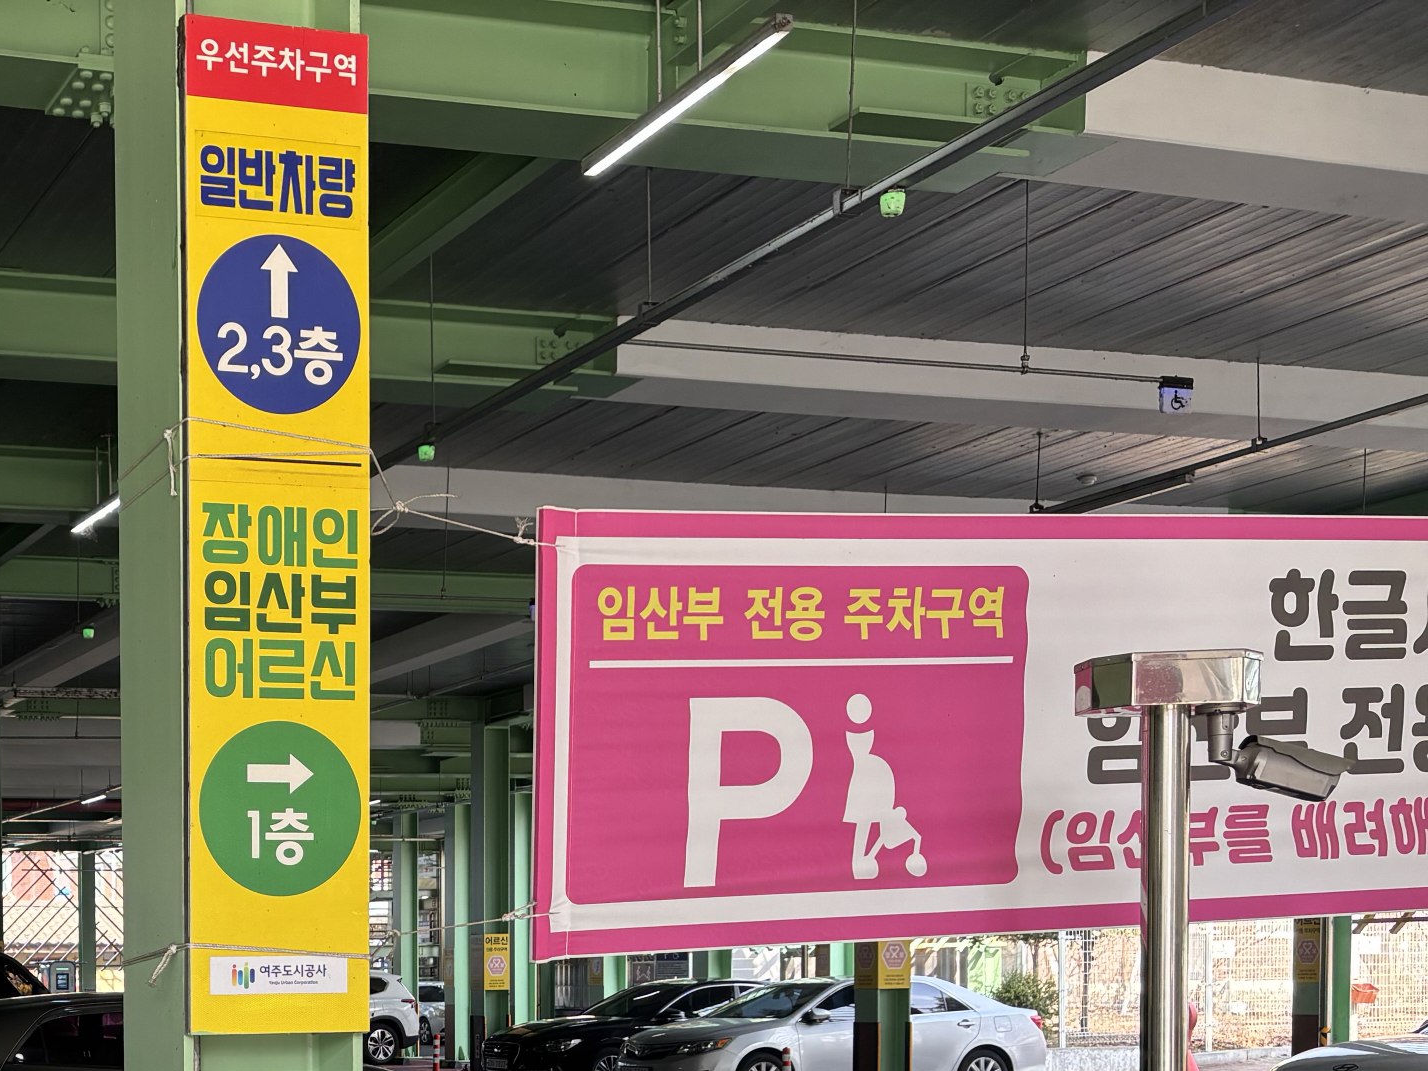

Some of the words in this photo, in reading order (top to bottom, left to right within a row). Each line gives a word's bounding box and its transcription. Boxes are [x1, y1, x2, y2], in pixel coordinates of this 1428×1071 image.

[196, 38, 357, 86] 우선주차구역
[199, 144, 356, 219] 일반차량
[217, 321, 343, 386] 2,3층
[201, 502, 359, 570] 장애인
[204, 571, 357, 634] 임산부
[597, 585, 724, 641] 임산부
[744, 586, 826, 641] 전용
[843, 585, 1005, 640] 주차구역
[204, 637, 356, 700] 어르신
[1339, 683, 1428, 776] 전
[684, 696, 814, 888] P
[247, 807, 315, 866] 1층
[259, 964, 327, 978] 여주도시공사
[485, 936, 508, 946] 어르신
